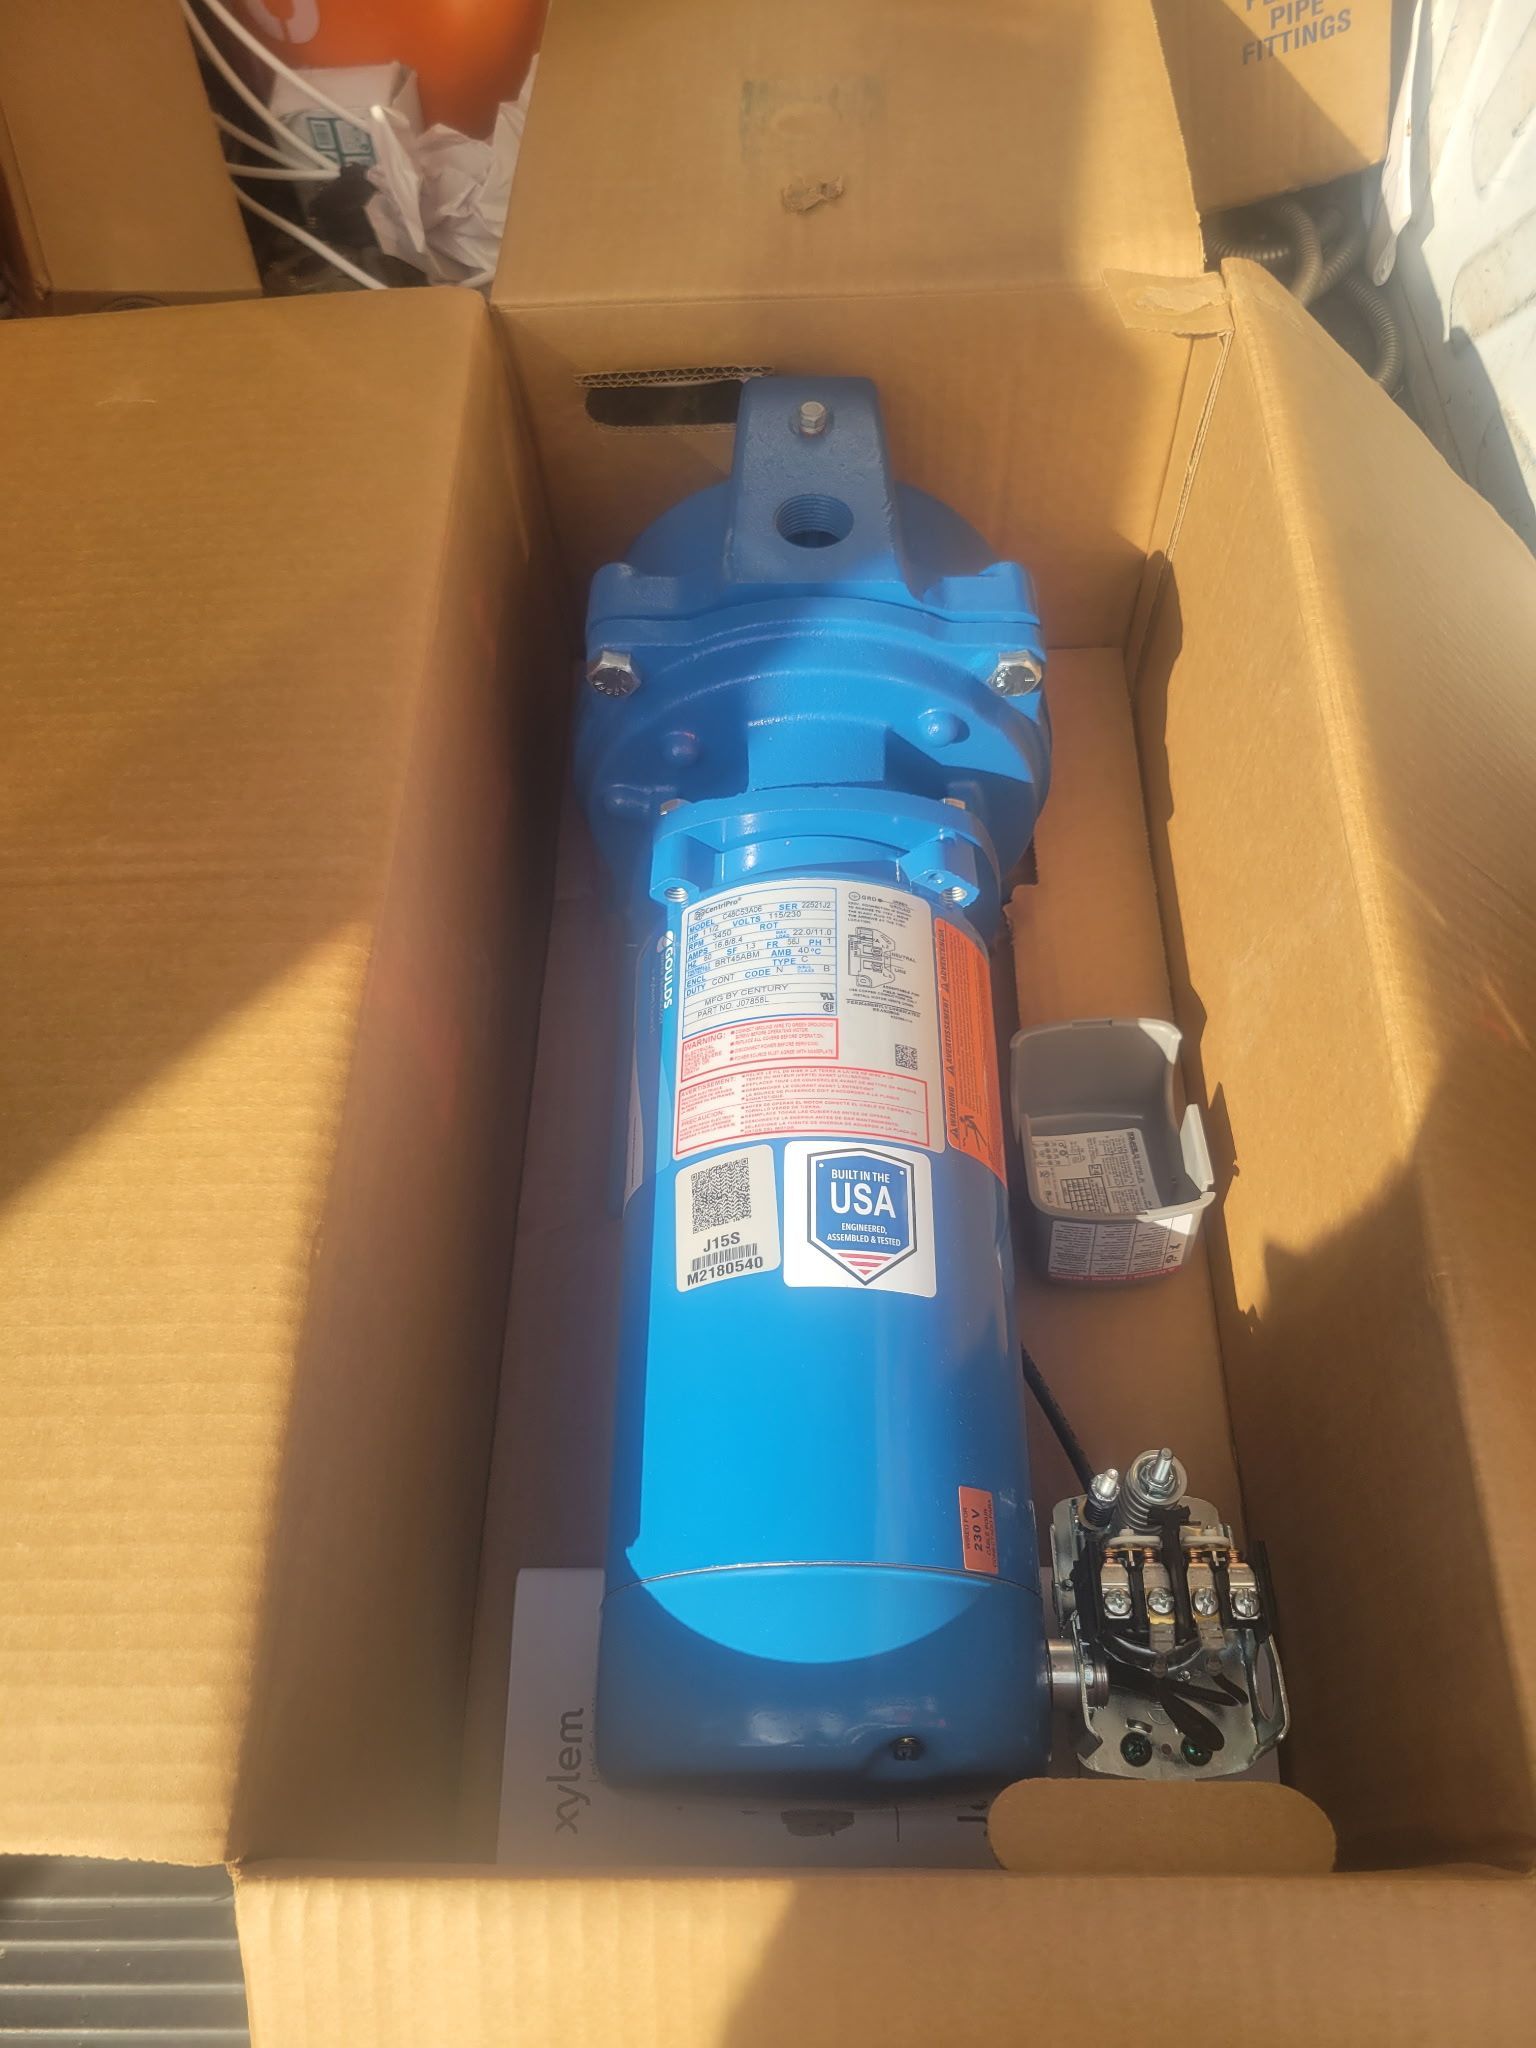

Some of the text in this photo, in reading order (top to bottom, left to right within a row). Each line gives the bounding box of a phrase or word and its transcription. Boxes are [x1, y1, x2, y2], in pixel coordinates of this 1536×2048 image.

[1270, 0, 1325, 30] PIPE
[1241, 8, 1352, 65] FITTINGS
[689, 934, 698, 942] HP
[732, 916, 760, 927] VOLTS
[769, 911, 802, 919] 115/230
[690, 919, 714, 932] MODEL
[778, 903, 798, 911] SER
[688, 922, 778, 951] RPM 3450 ROT
[688, 948, 708, 961] AMPS
[792, 928, 832, 936] 22.0/11.0
[688, 960, 696, 969] HZ
[766, 941, 779, 949] FR
[771, 949, 792, 957] AMB
[664, 946, 673, 1009] GOULDS
[686, 975, 706, 988] ENCL
[773, 958, 796, 966] TYPE
[686, 984, 706, 996] DUTY
[712, 974, 735, 985] CONT
[745, 969, 771, 978] CODE
[705, 984, 788, 1006] MFG BY CENTURY
[697, 1004, 717, 1018] PART
[684, 1033, 726, 1050] WARNING:
[943, 997, 953, 1064] AVERTISSEMENT
[949, 1086, 957, 1127] WARNING
[831, 1169, 890, 1184] BUILT IN THE
[830, 1182, 897, 1219] USA
[703, 1232, 740, 1253] J15S
[827, 1232, 901, 1247] ASSEMBLED & TESTED
[841, 1222, 888, 1235] ENGINEERED,
[686, 1256, 764, 1286] M2180540
[971, 1508, 983, 1552] 230 V
[545, 1708, 591, 1834] xylem
